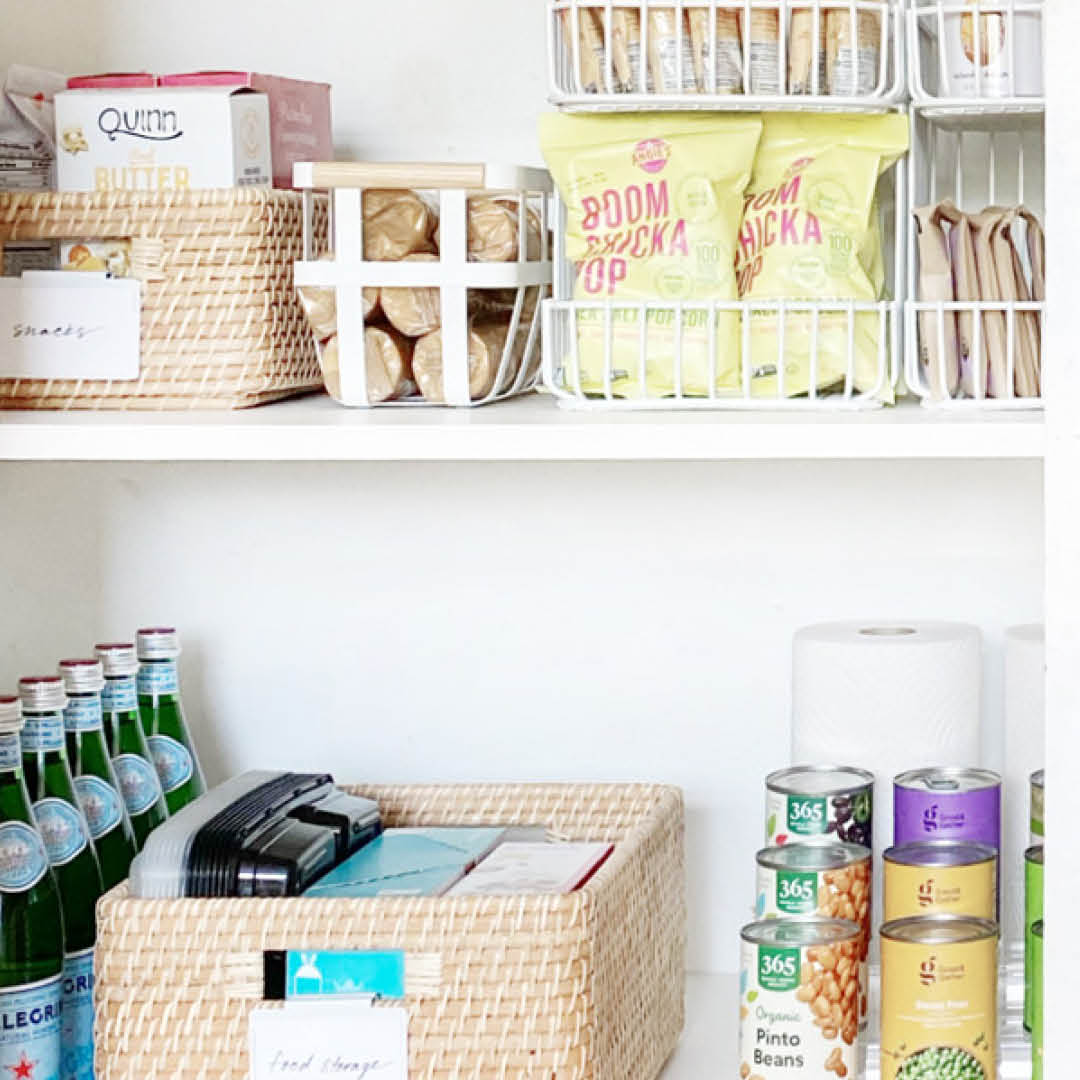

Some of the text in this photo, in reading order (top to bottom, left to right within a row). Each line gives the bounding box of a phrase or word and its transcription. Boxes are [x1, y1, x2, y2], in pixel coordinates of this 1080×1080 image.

[96, 166, 190, 189] BUTTER
[581, 179, 669, 231] BOOM
[735, 208, 822, 266] HICKA
[789, 801, 824, 821] 365
[778, 878, 814, 899] 365
[760, 954, 797, 976] 365
[755, 1006, 801, 1024] Organic
[756, 1028, 801, 1047] Pinto
[269, 1050, 314, 1071] food
[753, 1049, 804, 1068] Beans
